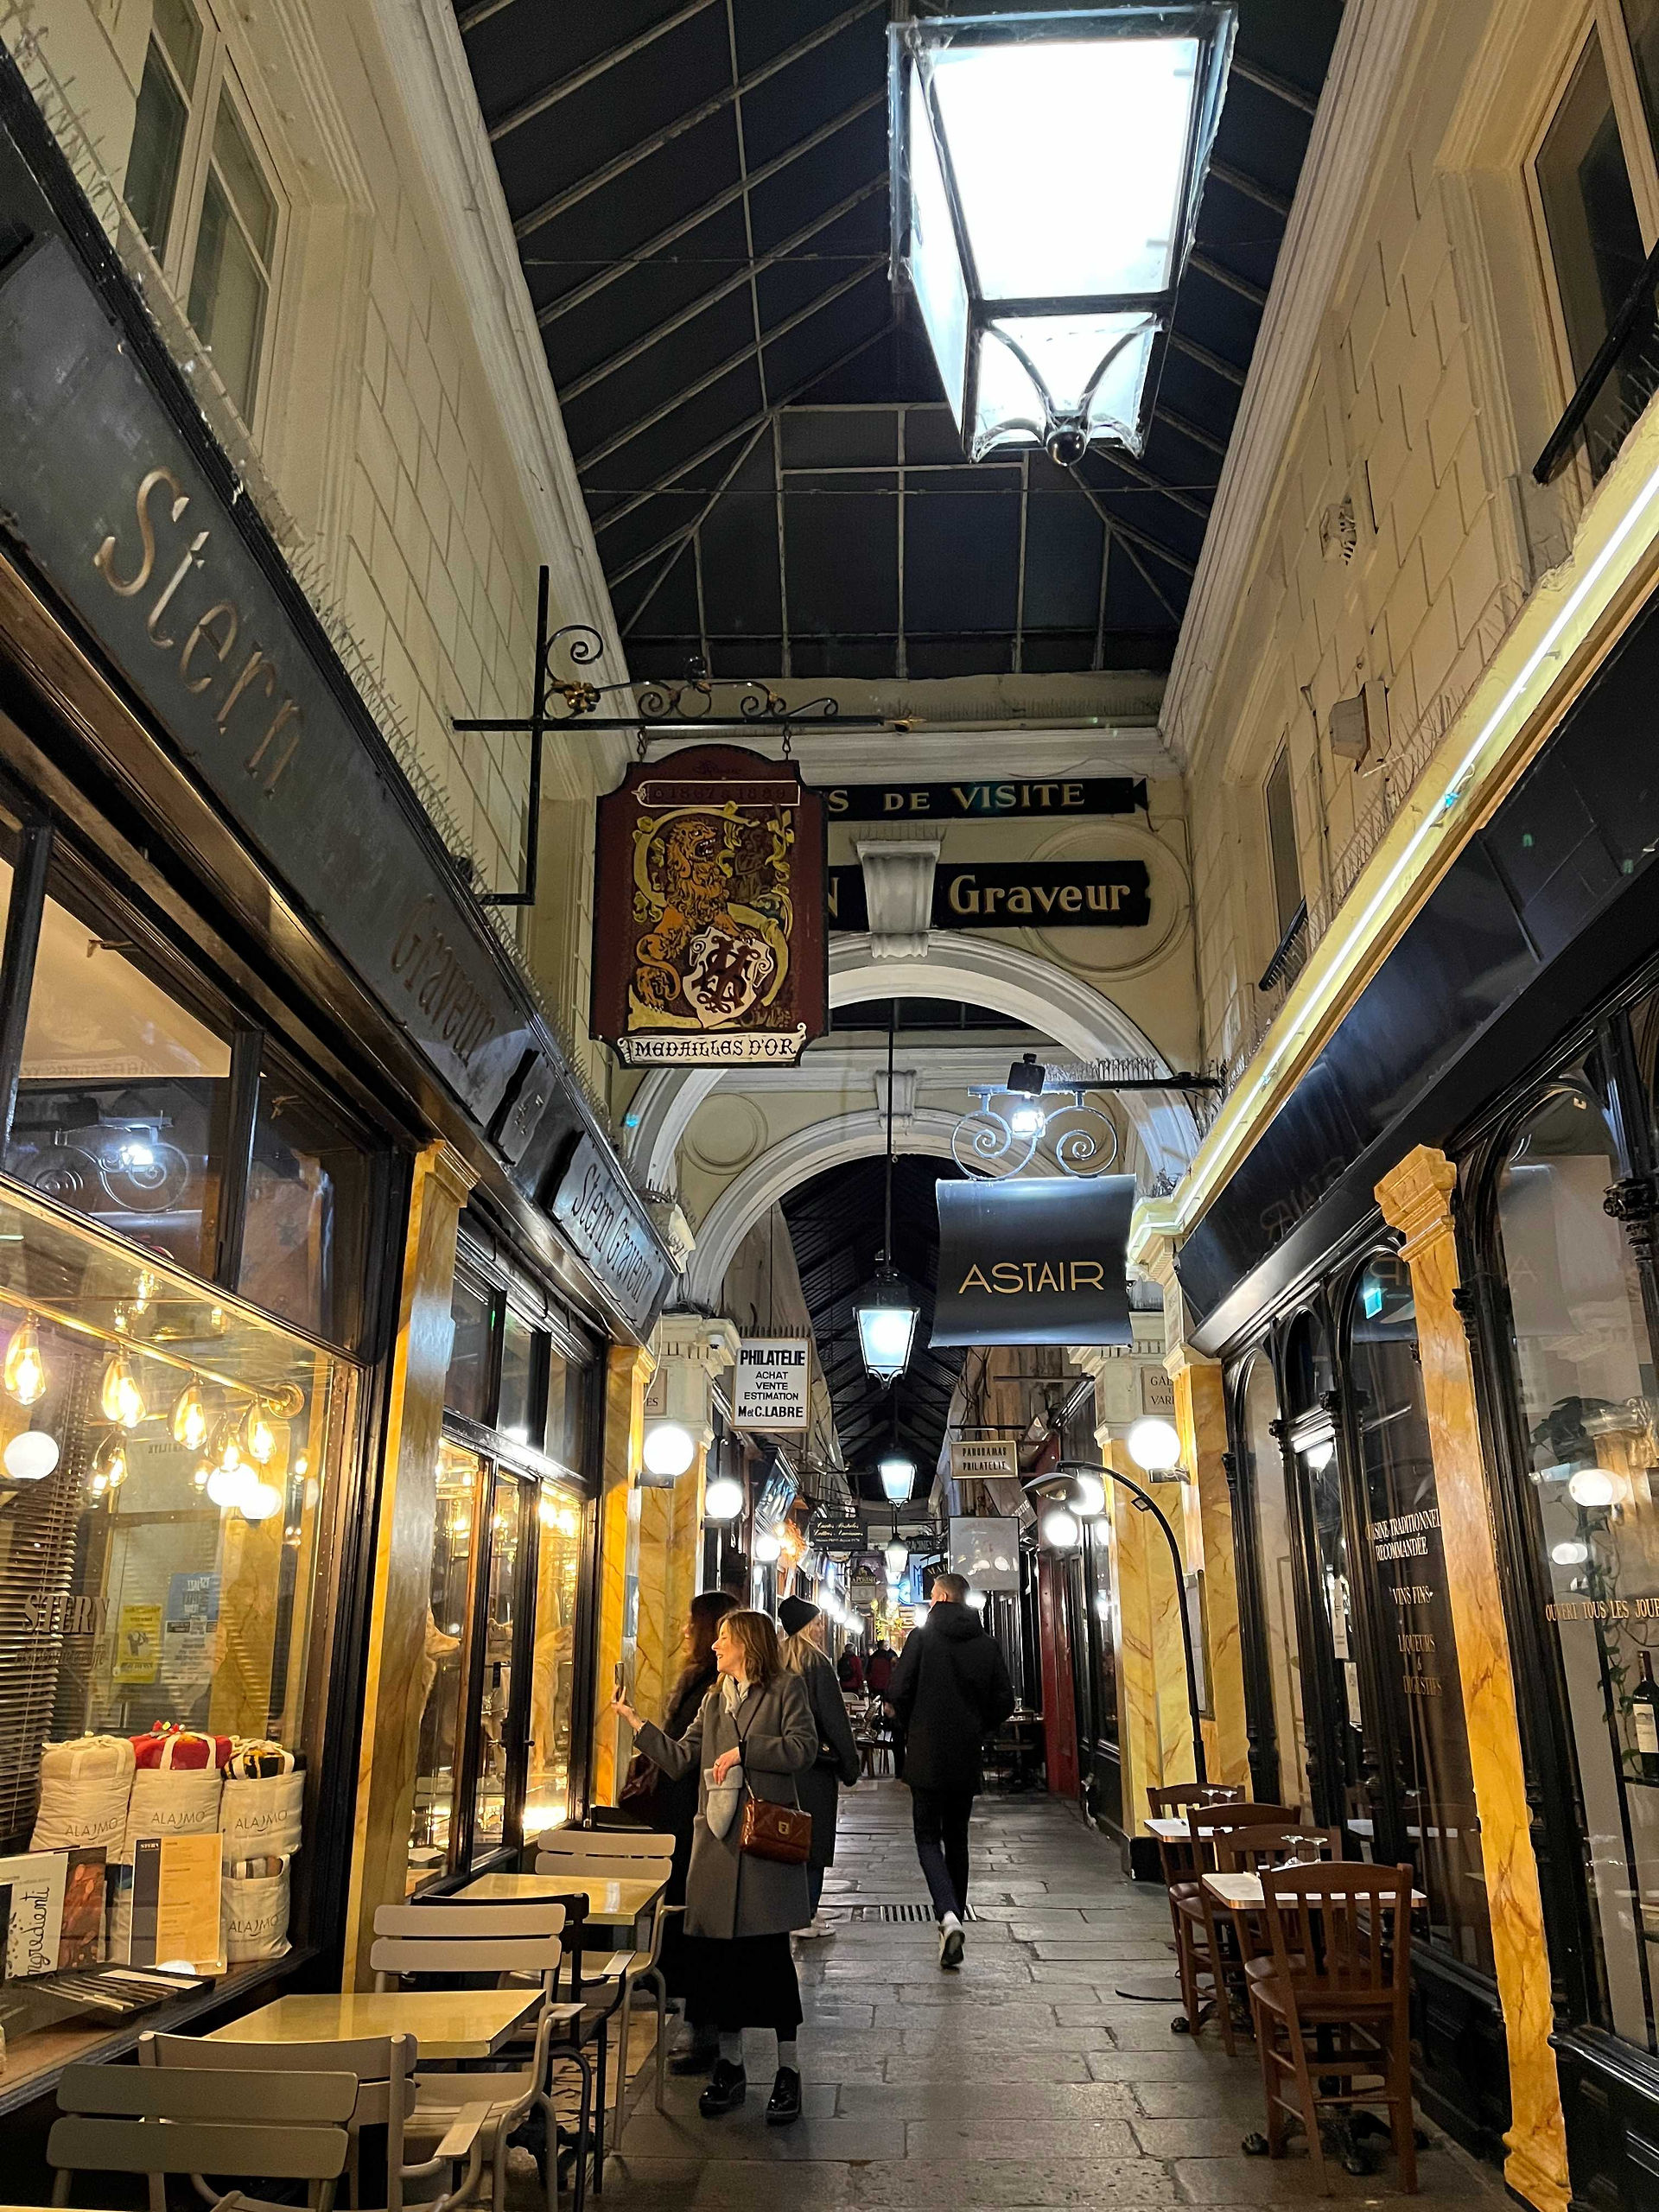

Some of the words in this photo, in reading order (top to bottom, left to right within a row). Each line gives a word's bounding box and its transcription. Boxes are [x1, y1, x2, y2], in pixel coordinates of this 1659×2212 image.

[93, 466, 304, 802] Stern
[883, 792, 931, 811] DE
[951, 783, 1086, 810] VISITE
[950, 874, 1131, 916] Graveur
[749, 1037, 797, 1056] D'OR
[957, 1261, 1105, 1294] ASTAIR
[962, 1447, 1007, 1457] PANORAMAS
[1375, 1533, 1428, 1561] RECOMMANDÉE
[1392, 1586, 1412, 1605] VINS
[1413, 1586, 1431, 1604] FINS
[1545, 1602, 1578, 1622] OUVERT
[1582, 1600, 1607, 1620] TOUS
[1609, 1599, 1630, 1619] LES
[1398, 1634, 1436, 1655] LIQUEURS
[65, 1817, 118, 1840] ALAJMO
[151, 1810, 206, 1829] ALAJMO
[235, 1810, 288, 1832] ALAJMO
[228, 1914, 279, 1937] ALAJMO
